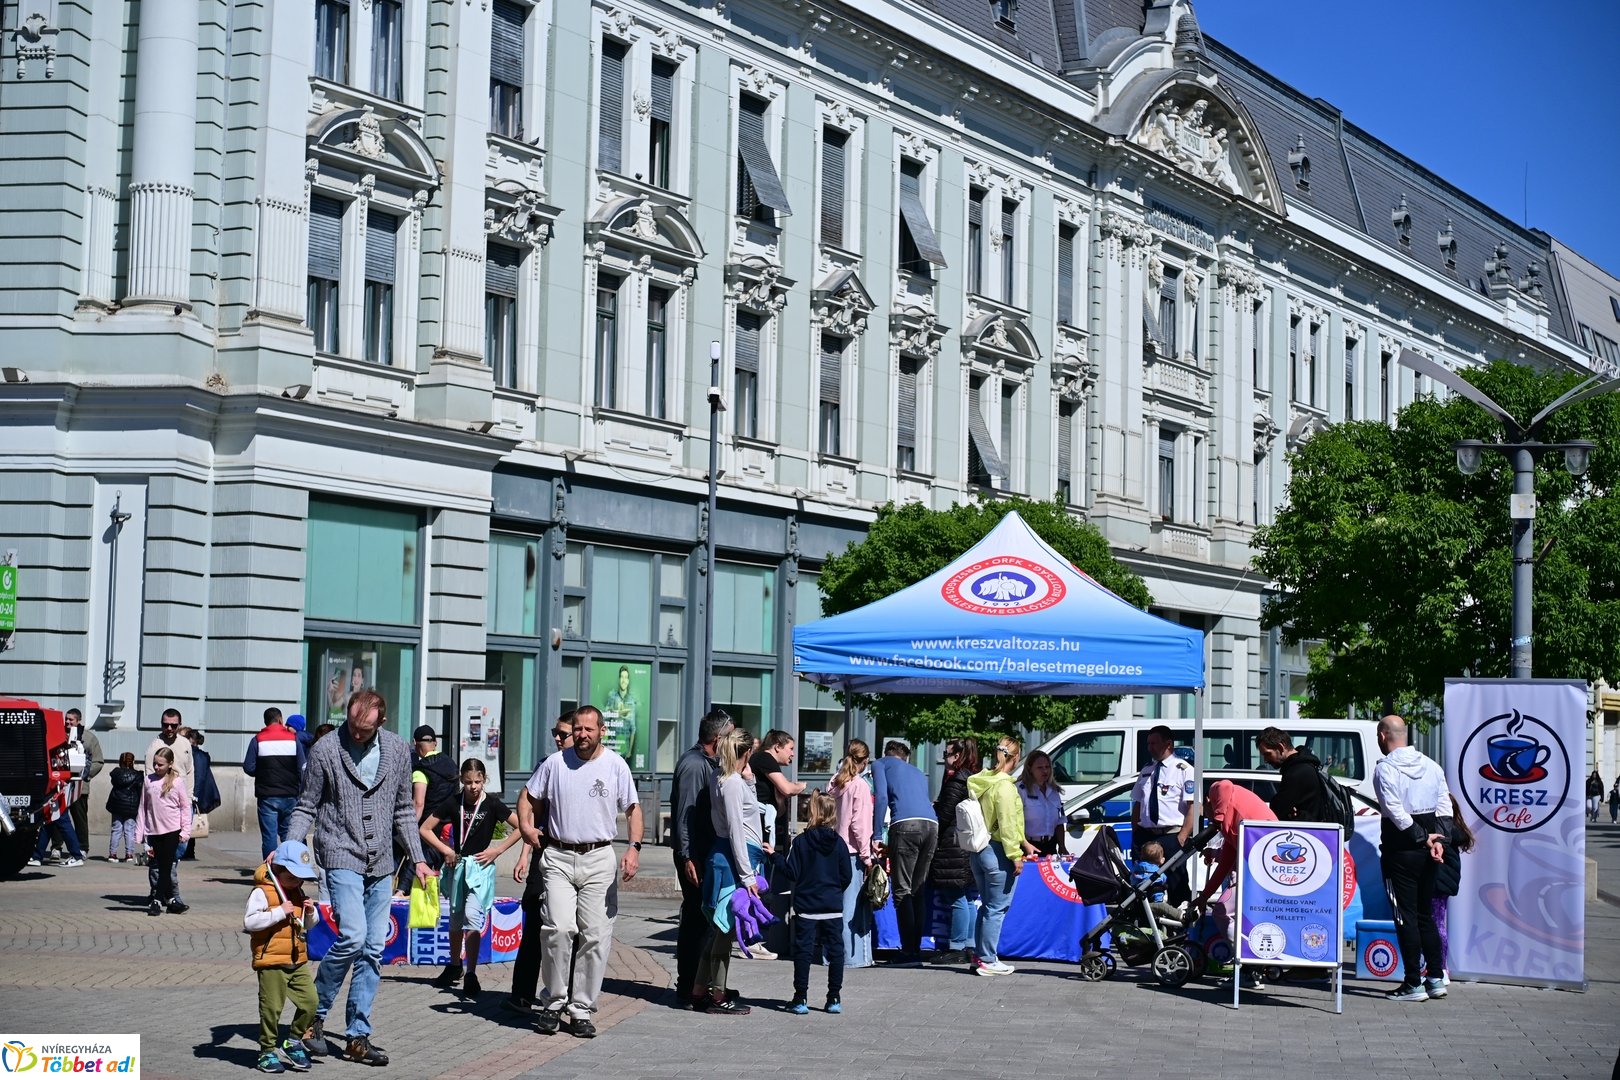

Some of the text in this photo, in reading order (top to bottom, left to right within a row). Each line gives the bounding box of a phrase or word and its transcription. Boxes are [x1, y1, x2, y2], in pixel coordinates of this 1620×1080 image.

[992, 557, 1024, 565] ORFK
[911, 636, 1080, 652] www.kreszvaltozas.hu
[849, 654, 1143, 676] www.facebook.com/balesetmegelozes
[1480, 787, 1548, 806] KRESZ
[1493, 806, 1532, 828] Cafe
[1271, 865, 1306, 874] KRESZ
[1279, 873, 1299, 883] Cafe
